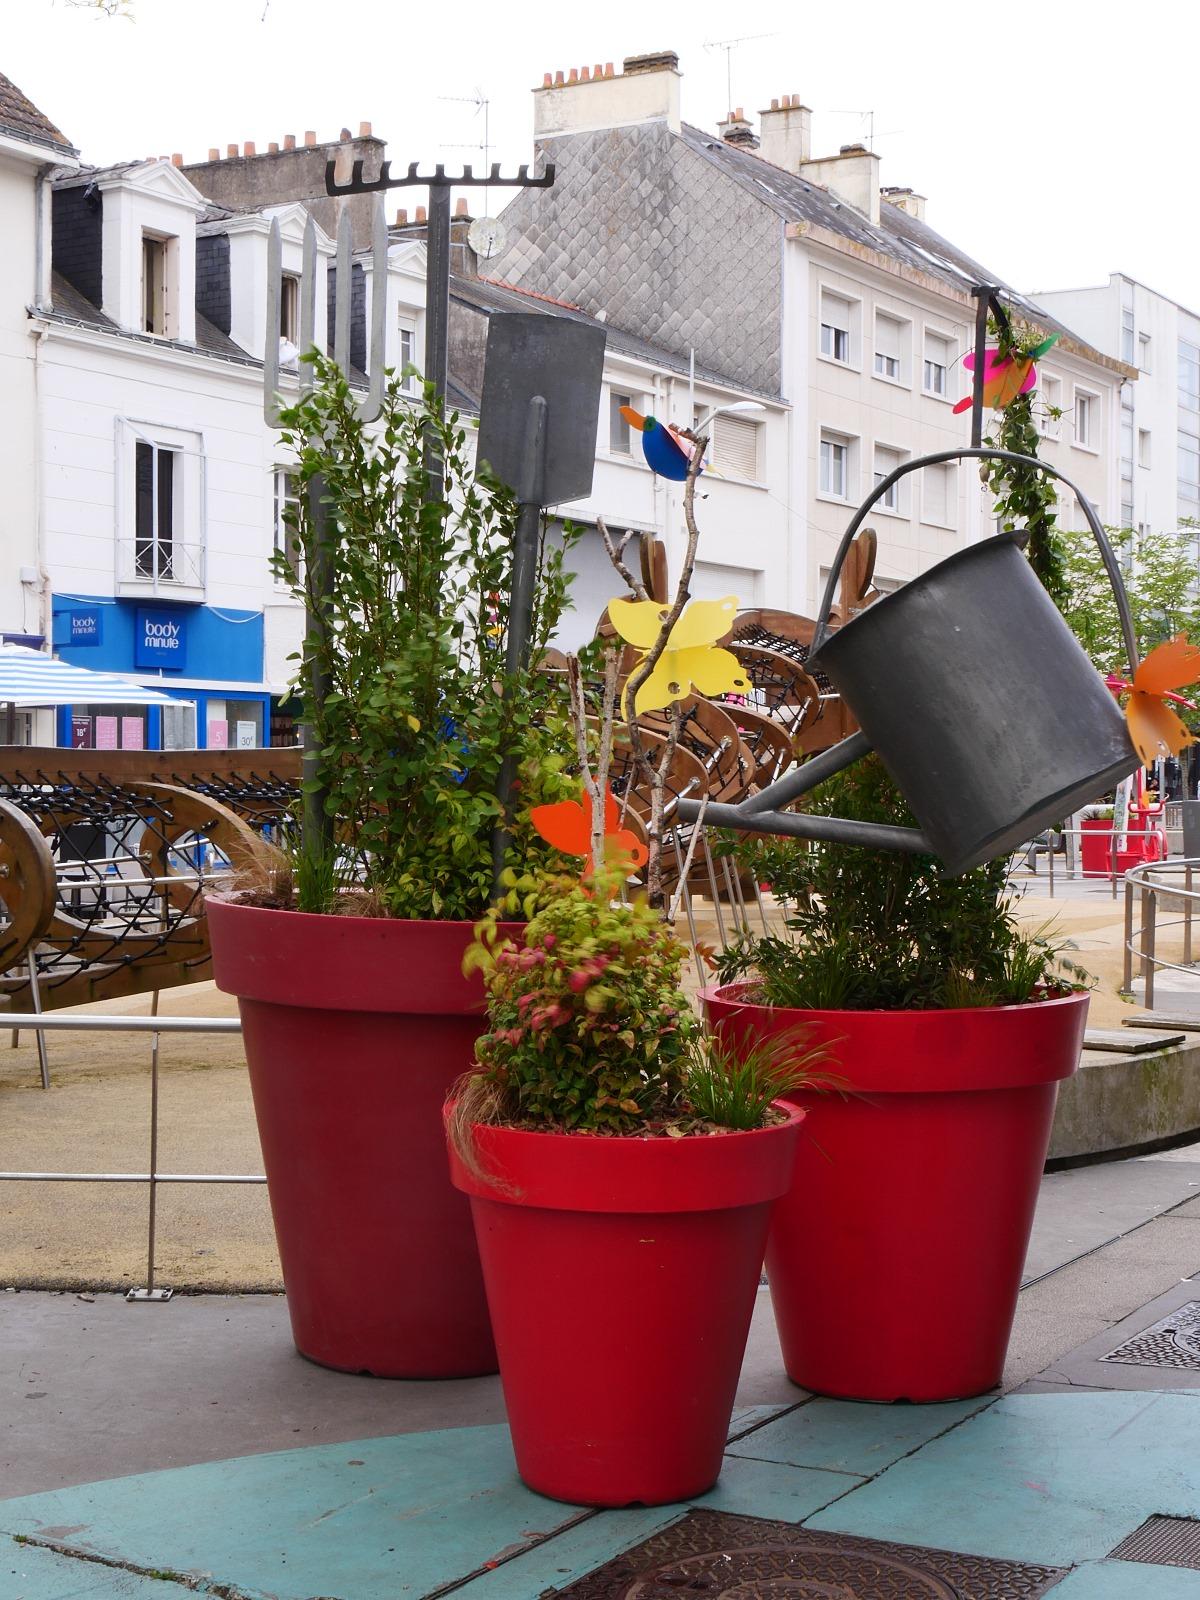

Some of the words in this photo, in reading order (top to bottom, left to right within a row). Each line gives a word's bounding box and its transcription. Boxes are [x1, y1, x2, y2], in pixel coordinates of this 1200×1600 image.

[72, 617, 96, 627] body
[145, 619, 180, 637] body
[145, 636, 179, 648] minute
